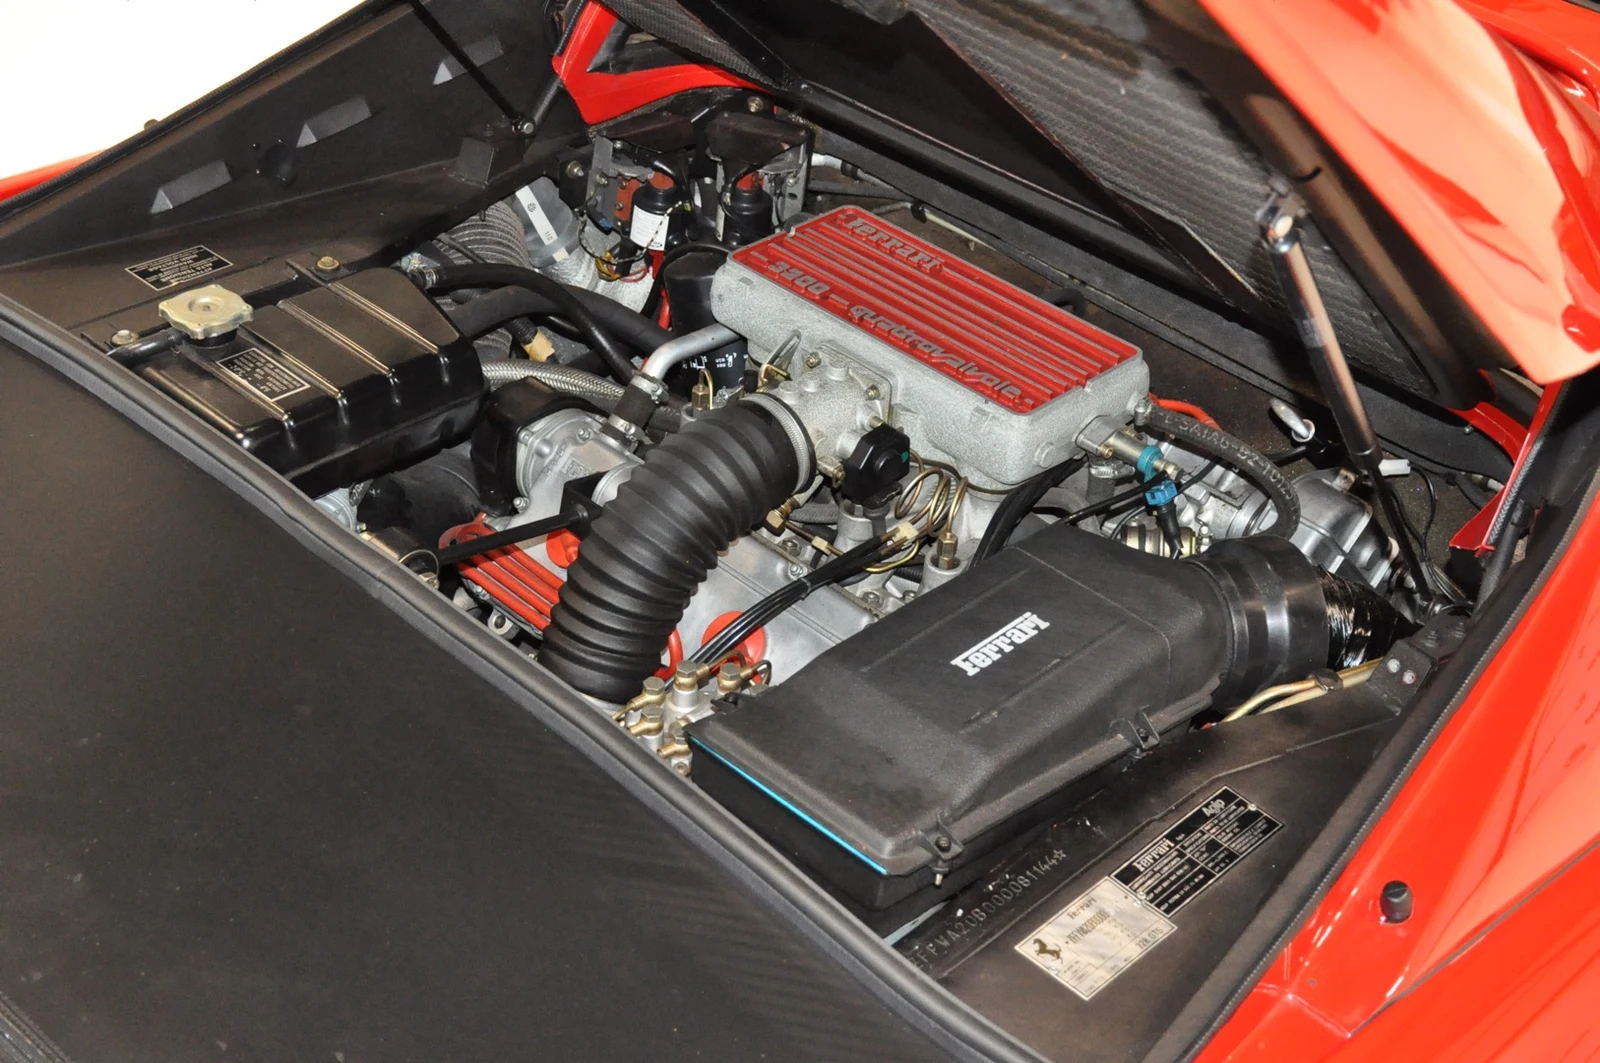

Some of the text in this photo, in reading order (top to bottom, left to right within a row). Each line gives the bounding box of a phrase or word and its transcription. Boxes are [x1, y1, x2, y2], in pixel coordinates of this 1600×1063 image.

[838, 214, 944, 271] Ferrari
[767, 261, 1022, 401] 3200 quattrovalvole
[950, 611, 1050, 677] Ferrari
[1201, 798, 1226, 817] Agip
[1132, 838, 1175, 872] Ferrari
[1067, 896, 1097, 919] Ferrari
